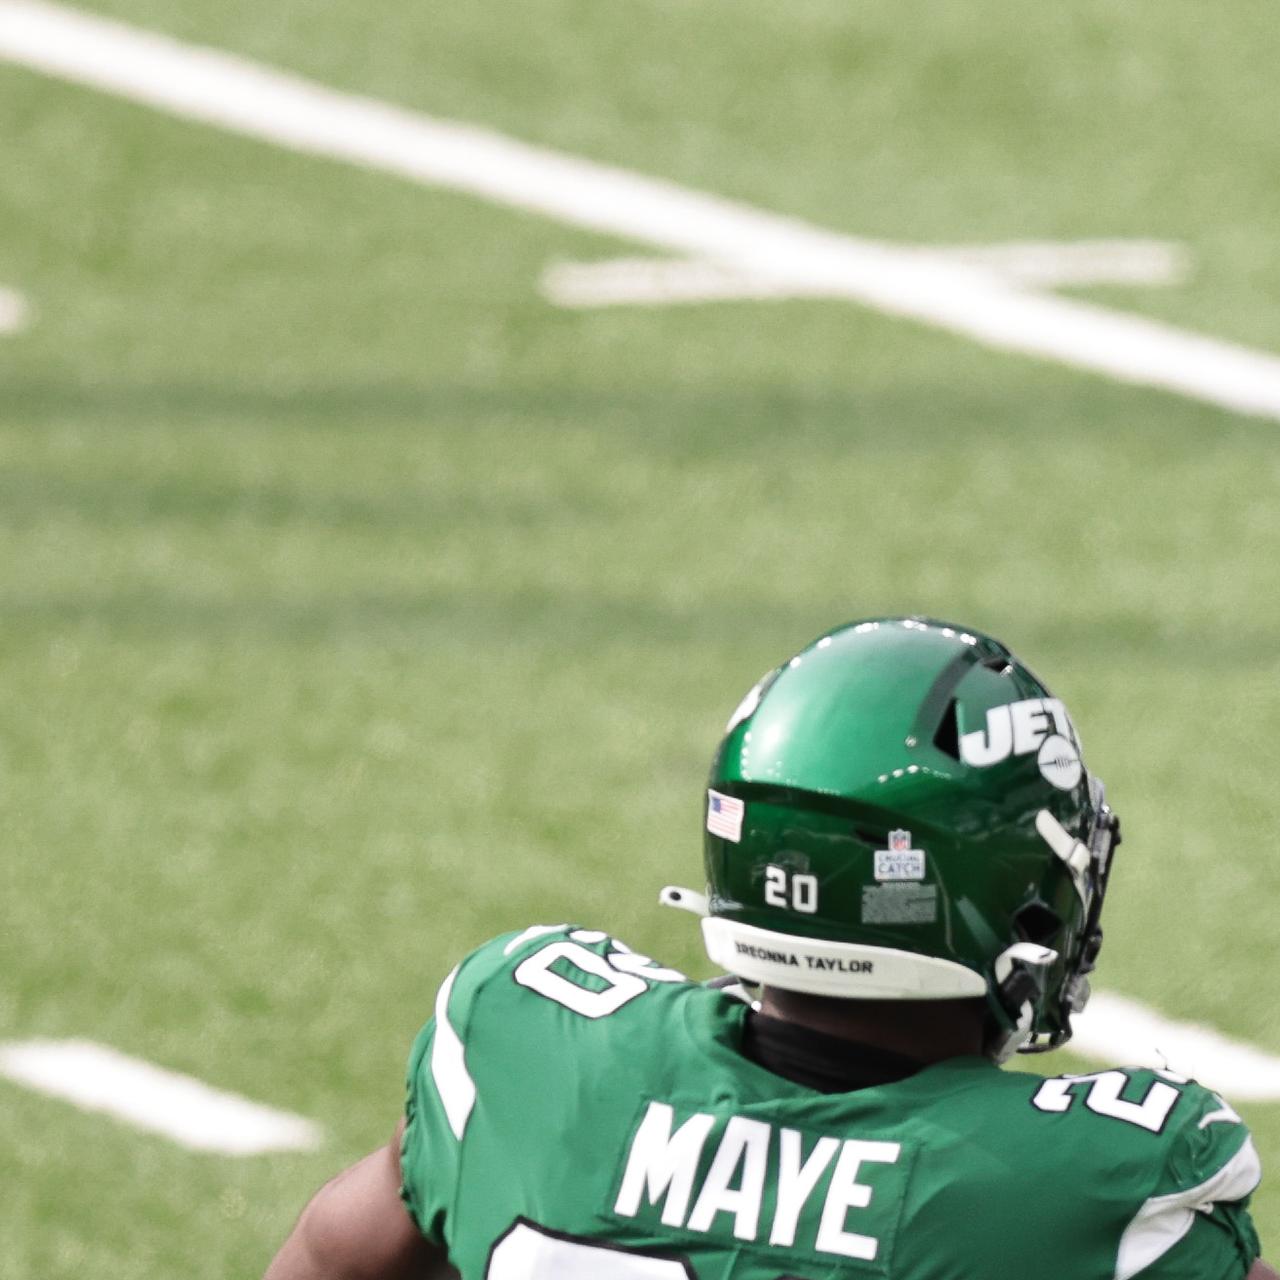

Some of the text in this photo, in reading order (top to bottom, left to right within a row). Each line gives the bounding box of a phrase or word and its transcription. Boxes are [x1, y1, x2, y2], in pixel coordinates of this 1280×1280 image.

[960, 698, 1082, 767] JET
[765, 864, 818, 914] 20
[804, 955, 874, 974] TAYLOR
[1030, 1066, 1190, 1135] 2
[613, 1102, 901, 1261] MAYE
